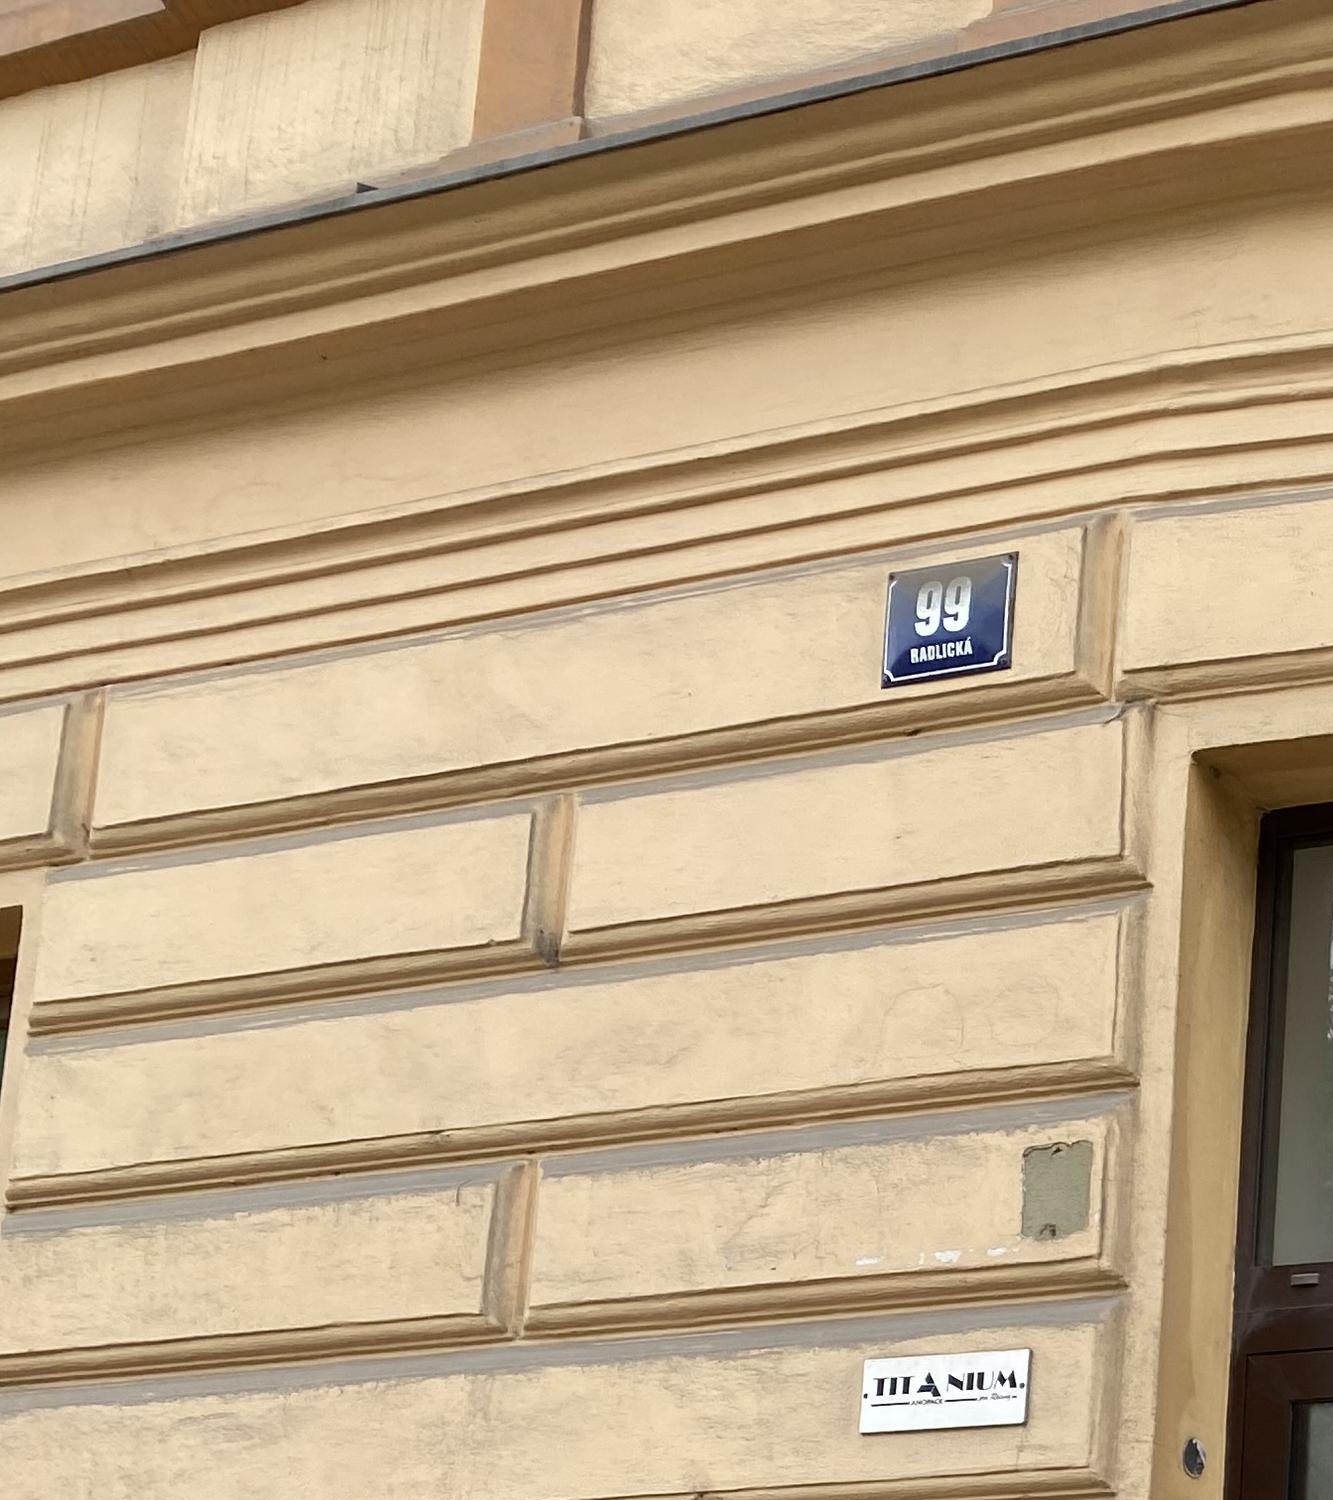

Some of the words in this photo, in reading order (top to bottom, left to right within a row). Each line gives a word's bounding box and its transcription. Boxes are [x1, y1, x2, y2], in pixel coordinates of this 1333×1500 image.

[914, 576, 972, 637] 99
[910, 636, 973, 663] RADLICKÁ
[873, 1370, 1018, 1397] TITANIUM
